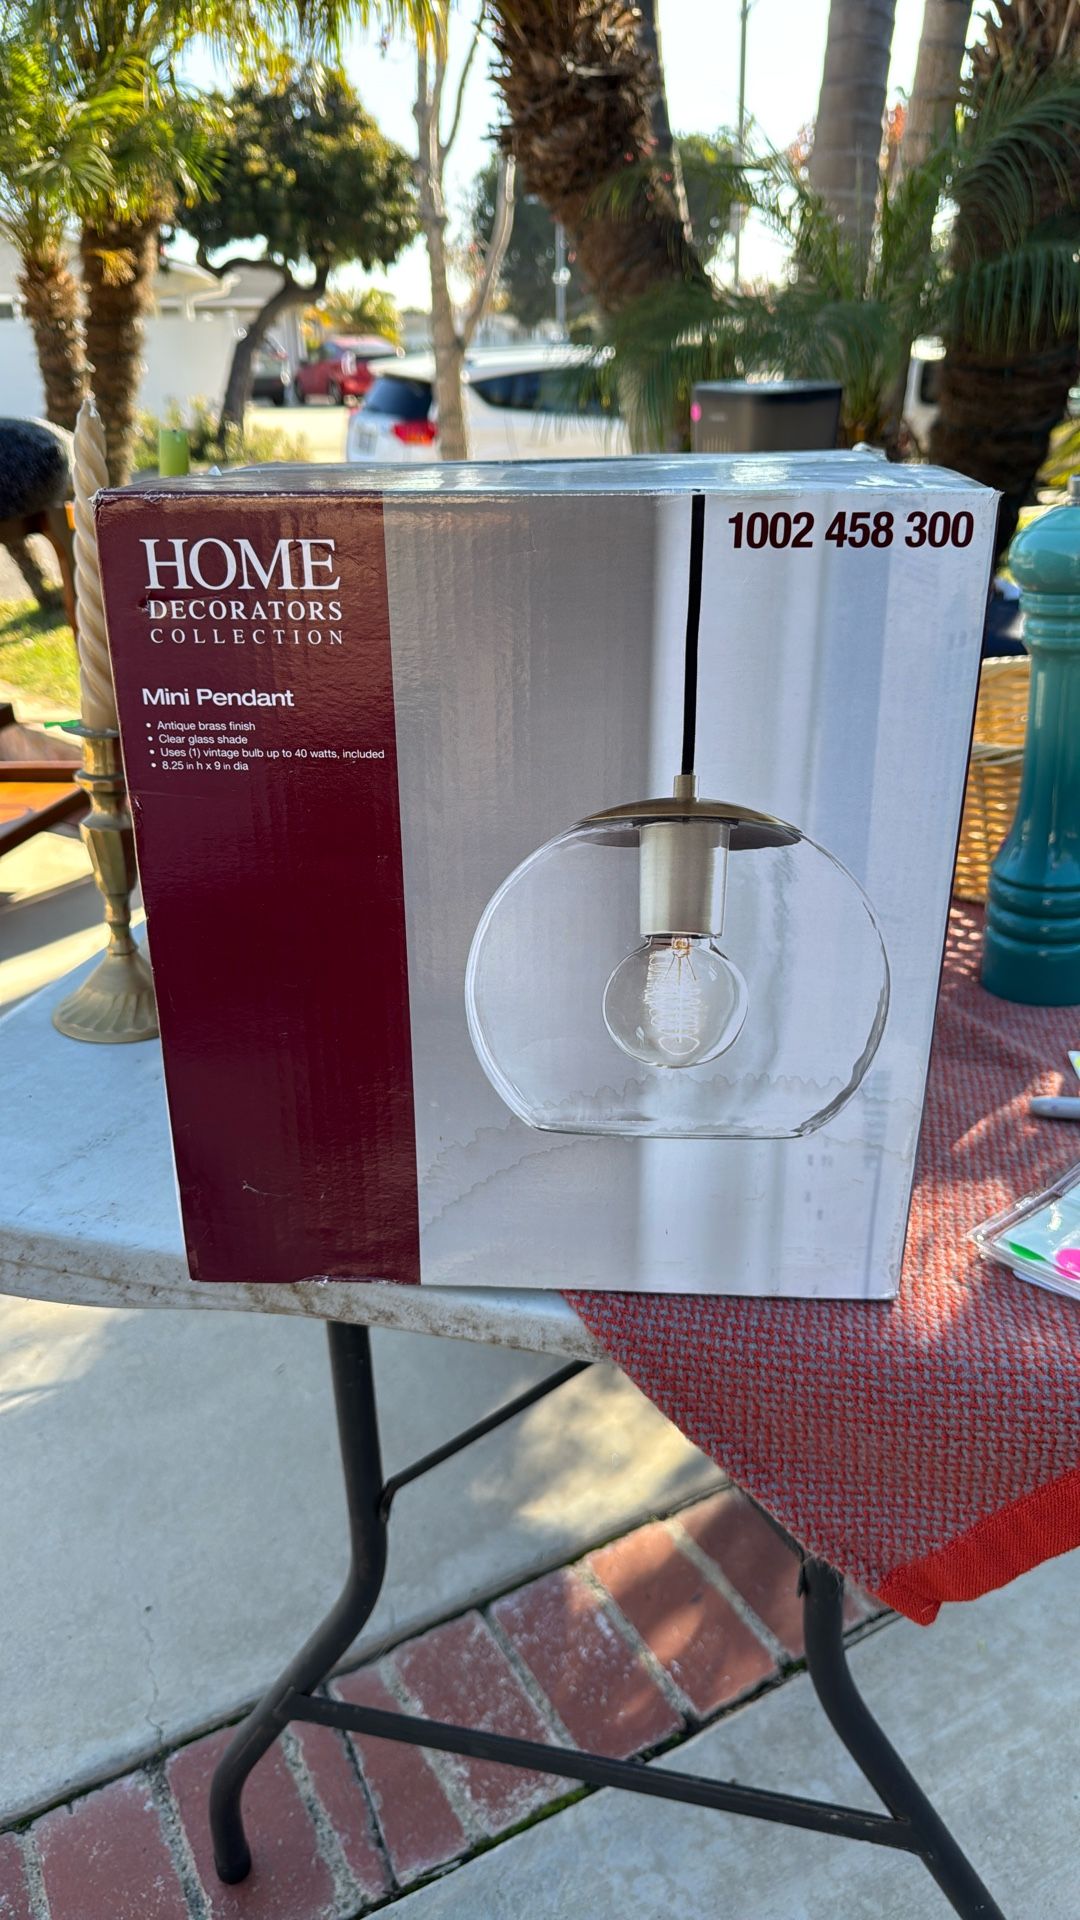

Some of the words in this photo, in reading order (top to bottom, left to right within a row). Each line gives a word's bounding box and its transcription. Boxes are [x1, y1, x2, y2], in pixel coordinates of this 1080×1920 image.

[728, 511, 815, 550] 1002
[824, 511, 894, 550] 458
[904, 510, 974, 549] 300
[139, 537, 341, 591] HOME
[149, 600, 342, 621] DECORATORS
[150, 628, 343, 645] COLLECTION
[142, 687, 190, 705] Mini
[196, 688, 295, 707] Pendant
[157, 720, 196, 732] Antique
[198, 721, 227, 731] brass
[229, 721, 256, 731] finish
[158, 734, 185, 744] Clear
[188, 734, 215, 746] glass
[217, 735, 248, 744] shade
[160, 747, 186, 757] Uses
[188, 748, 201, 759] (1)
[203, 748, 239, 759] vintage
[241, 748, 264, 758] bulb
[266, 750, 280, 760] up
[282, 749, 292, 758] to
[294, 748, 308, 758] 40
[310, 750, 340, 760] watts,
[342, 749, 385, 759] included
[161, 761, 184, 770] 8.25
[186, 762, 194, 770] in
[196, 761, 203, 770] h
[214, 761, 221, 770] 9
[223, 762, 231, 770] in
[233, 761, 249, 771] dia
